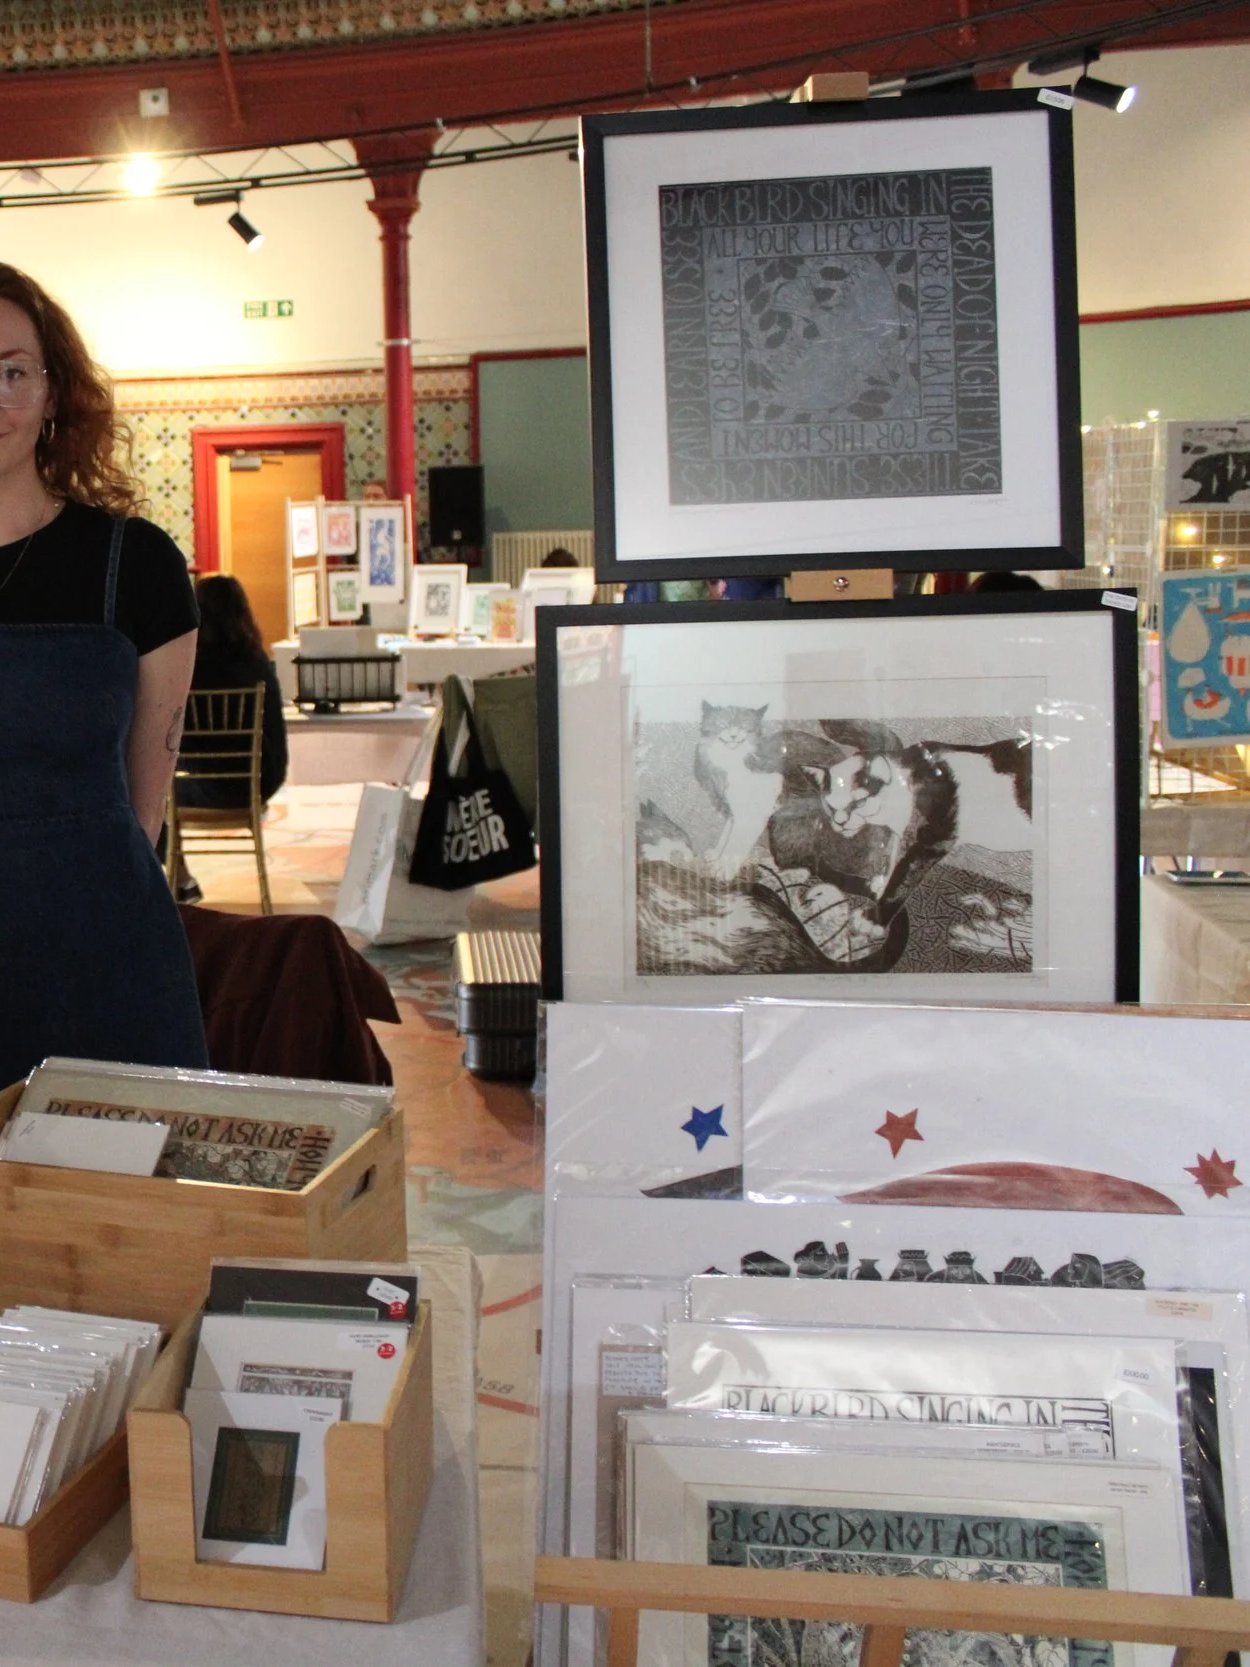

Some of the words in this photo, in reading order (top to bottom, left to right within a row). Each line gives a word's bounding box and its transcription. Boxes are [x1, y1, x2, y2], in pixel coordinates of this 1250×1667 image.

[661, 183, 803, 227] BLACKBIRD
[809, 176, 911, 220] SINGING
[918, 173, 948, 215] IN
[951, 169, 992, 213] THE
[661, 231, 701, 279] SEE
[707, 228, 740, 257] ALL
[744, 225, 800, 255] YOUR
[813, 222, 863, 252] LIFE
[869, 220, 914, 249] YOU
[952, 221, 994, 291] DEAD
[708, 289, 739, 346] FREE
[955, 295, 996, 333] OF
[711, 359, 741, 388] BE
[921, 350, 955, 444] WAITING
[956, 340, 999, 417] NIGHT
[670, 406, 711, 461] AND
[722, 426, 811, 457] MOMENT
[818, 424, 867, 452] THIS
[877, 422, 918, 449] FOR
[958, 427, 1001, 488] TAKE
[170, 1115, 219, 1142] NOT
[218, 1121, 268, 1146] ASK
[268, 1127, 303, 1149] ME
[709, 1507, 831, 1547] PLEASE
[837, 1513, 877, 1549] DO
[884, 1516, 945, 1553] NOT
[953, 1521, 1012, 1557] ASK
[1019, 1525, 1061, 1561] ME
